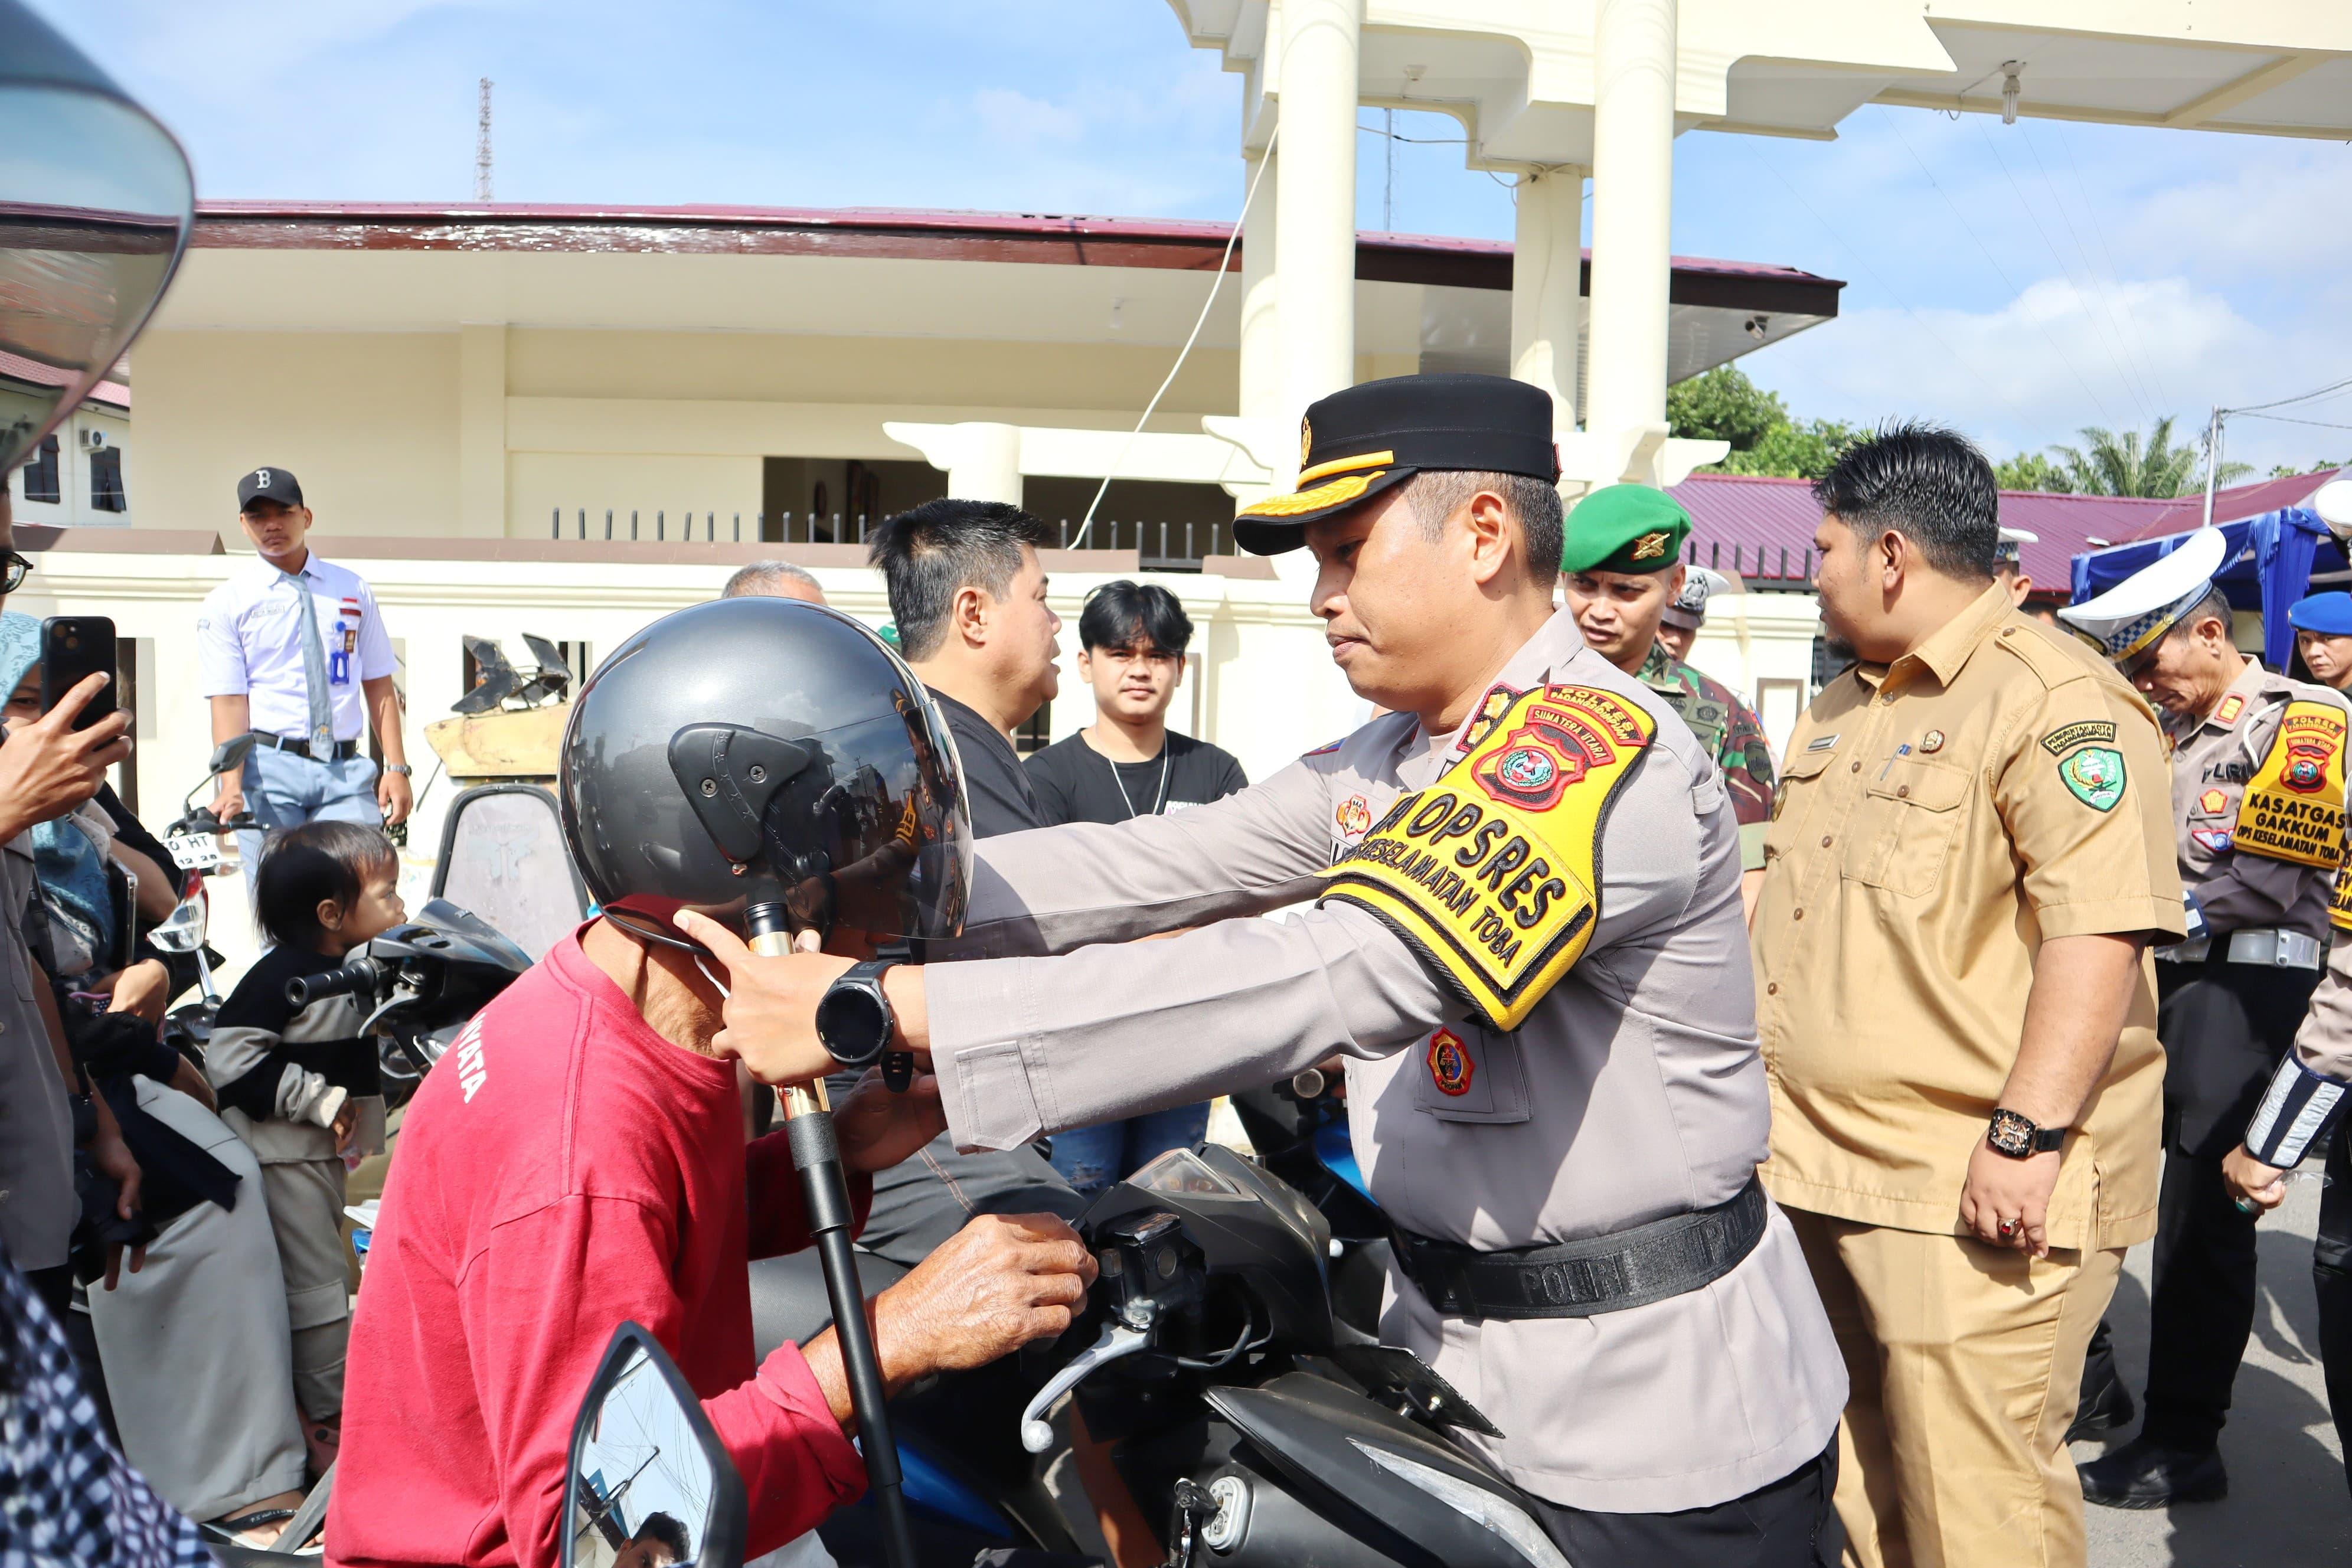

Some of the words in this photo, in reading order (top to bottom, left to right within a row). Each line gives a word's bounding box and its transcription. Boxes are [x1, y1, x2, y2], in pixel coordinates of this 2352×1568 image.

[256, 469, 272, 489] B
[1561, 688, 1635, 732] POLRES
[1534, 710, 1582, 734] SUMATERA
[1580, 733, 1608, 759] UTARA
[2249, 793, 2346, 829] KASATGAS
[2255, 812, 2330, 842] GAKKUM
[187, 835, 208, 849] HT
[2252, 829, 2317, 855] KESELAMATAN
[2318, 845, 2340, 862] TOBA
[1407, 793, 1566, 929] OPSRES
[1469, 906, 1523, 968] TOBA
